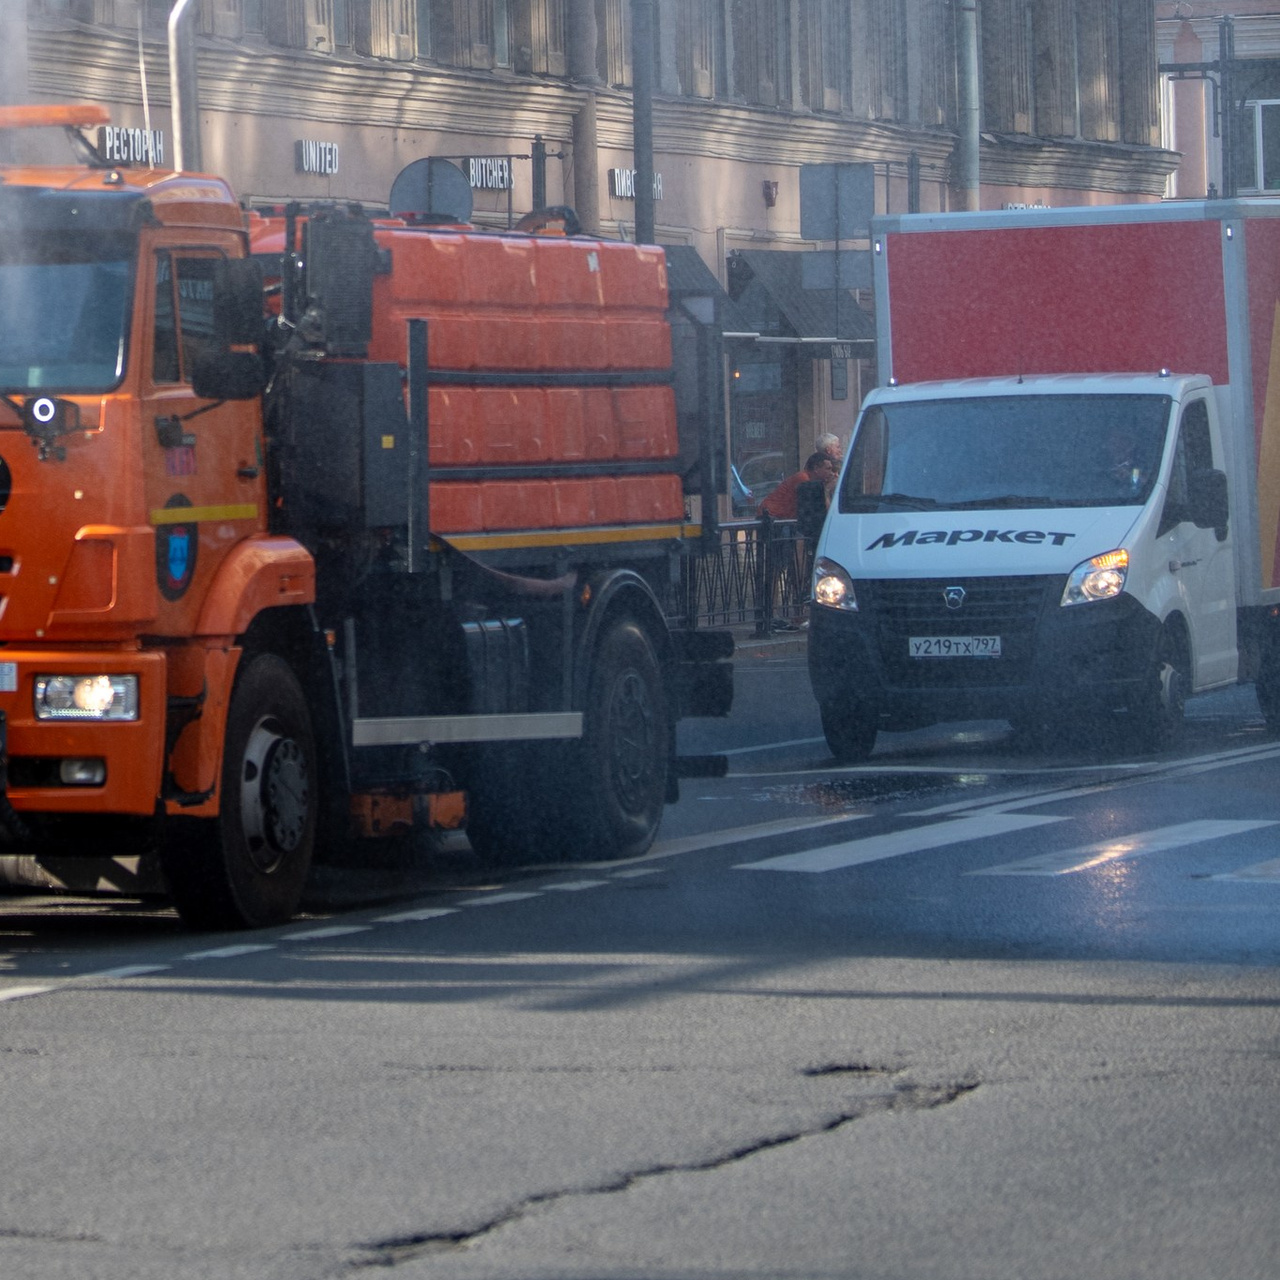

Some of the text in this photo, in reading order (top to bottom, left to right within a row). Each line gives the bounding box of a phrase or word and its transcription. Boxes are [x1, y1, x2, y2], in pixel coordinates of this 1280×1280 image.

[105, 126, 163, 164] РЕСТОРАН
[302, 139, 339, 174] UNITED
[864, 529, 1076, 551] Маркет
[974, 637, 996, 650] 797
